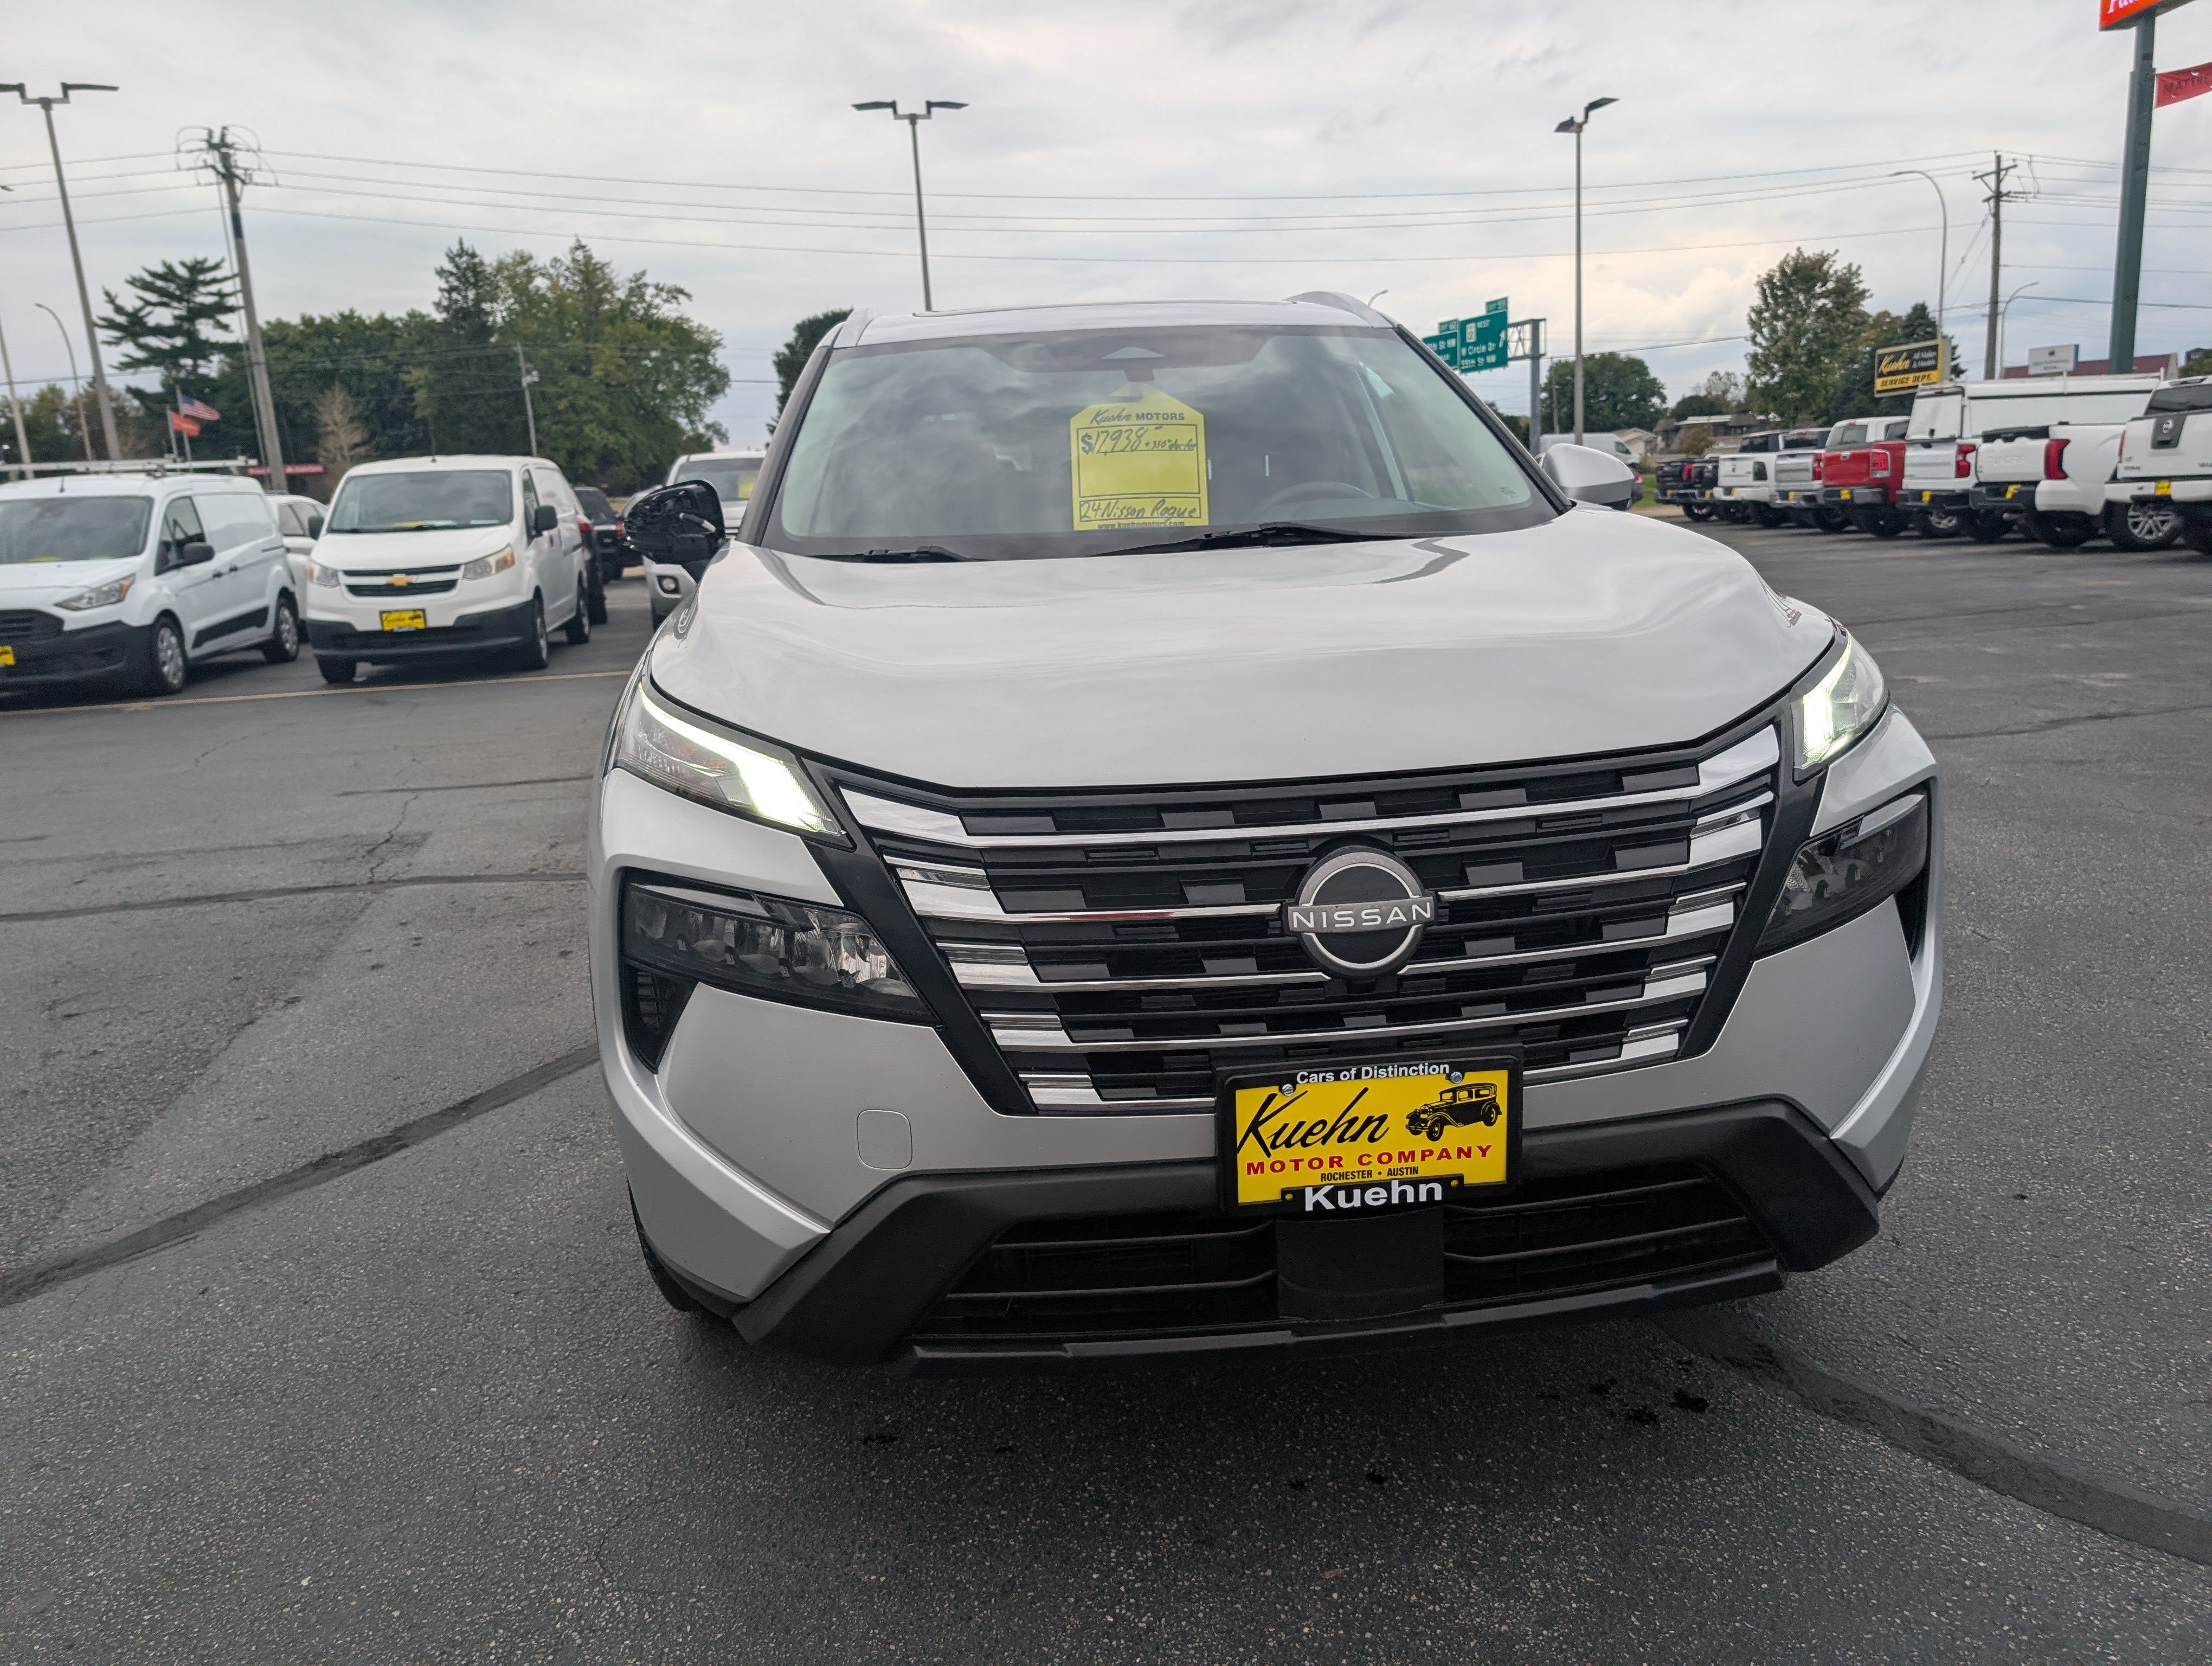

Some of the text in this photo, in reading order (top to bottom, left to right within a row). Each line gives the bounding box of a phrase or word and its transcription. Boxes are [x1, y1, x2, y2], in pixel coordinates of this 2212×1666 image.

[2164, 75, 2212, 94] MATTRE
[1468, 344, 1487, 356] Circle
[1488, 342, 1496, 352] Dr
[1878, 351, 1911, 375] Kuehn
[1880, 373, 1931, 388] SERVICE DEPT.
[1090, 408, 1185, 425] Kuehn MOTORS
[1150, 497, 1197, 522] Rogue
[1292, 902, 1431, 928] NISSAN
[1296, 1062, 1450, 1085] Cars of Distinction
[1237, 1086, 1390, 1159] Kuehn
[1246, 1144, 1493, 1175] MOTOR COMPANY
[1320, 1165, 1419, 1182] ROCHESTER AUSTIN
[1304, 1179, 1443, 1212] Kuehn
